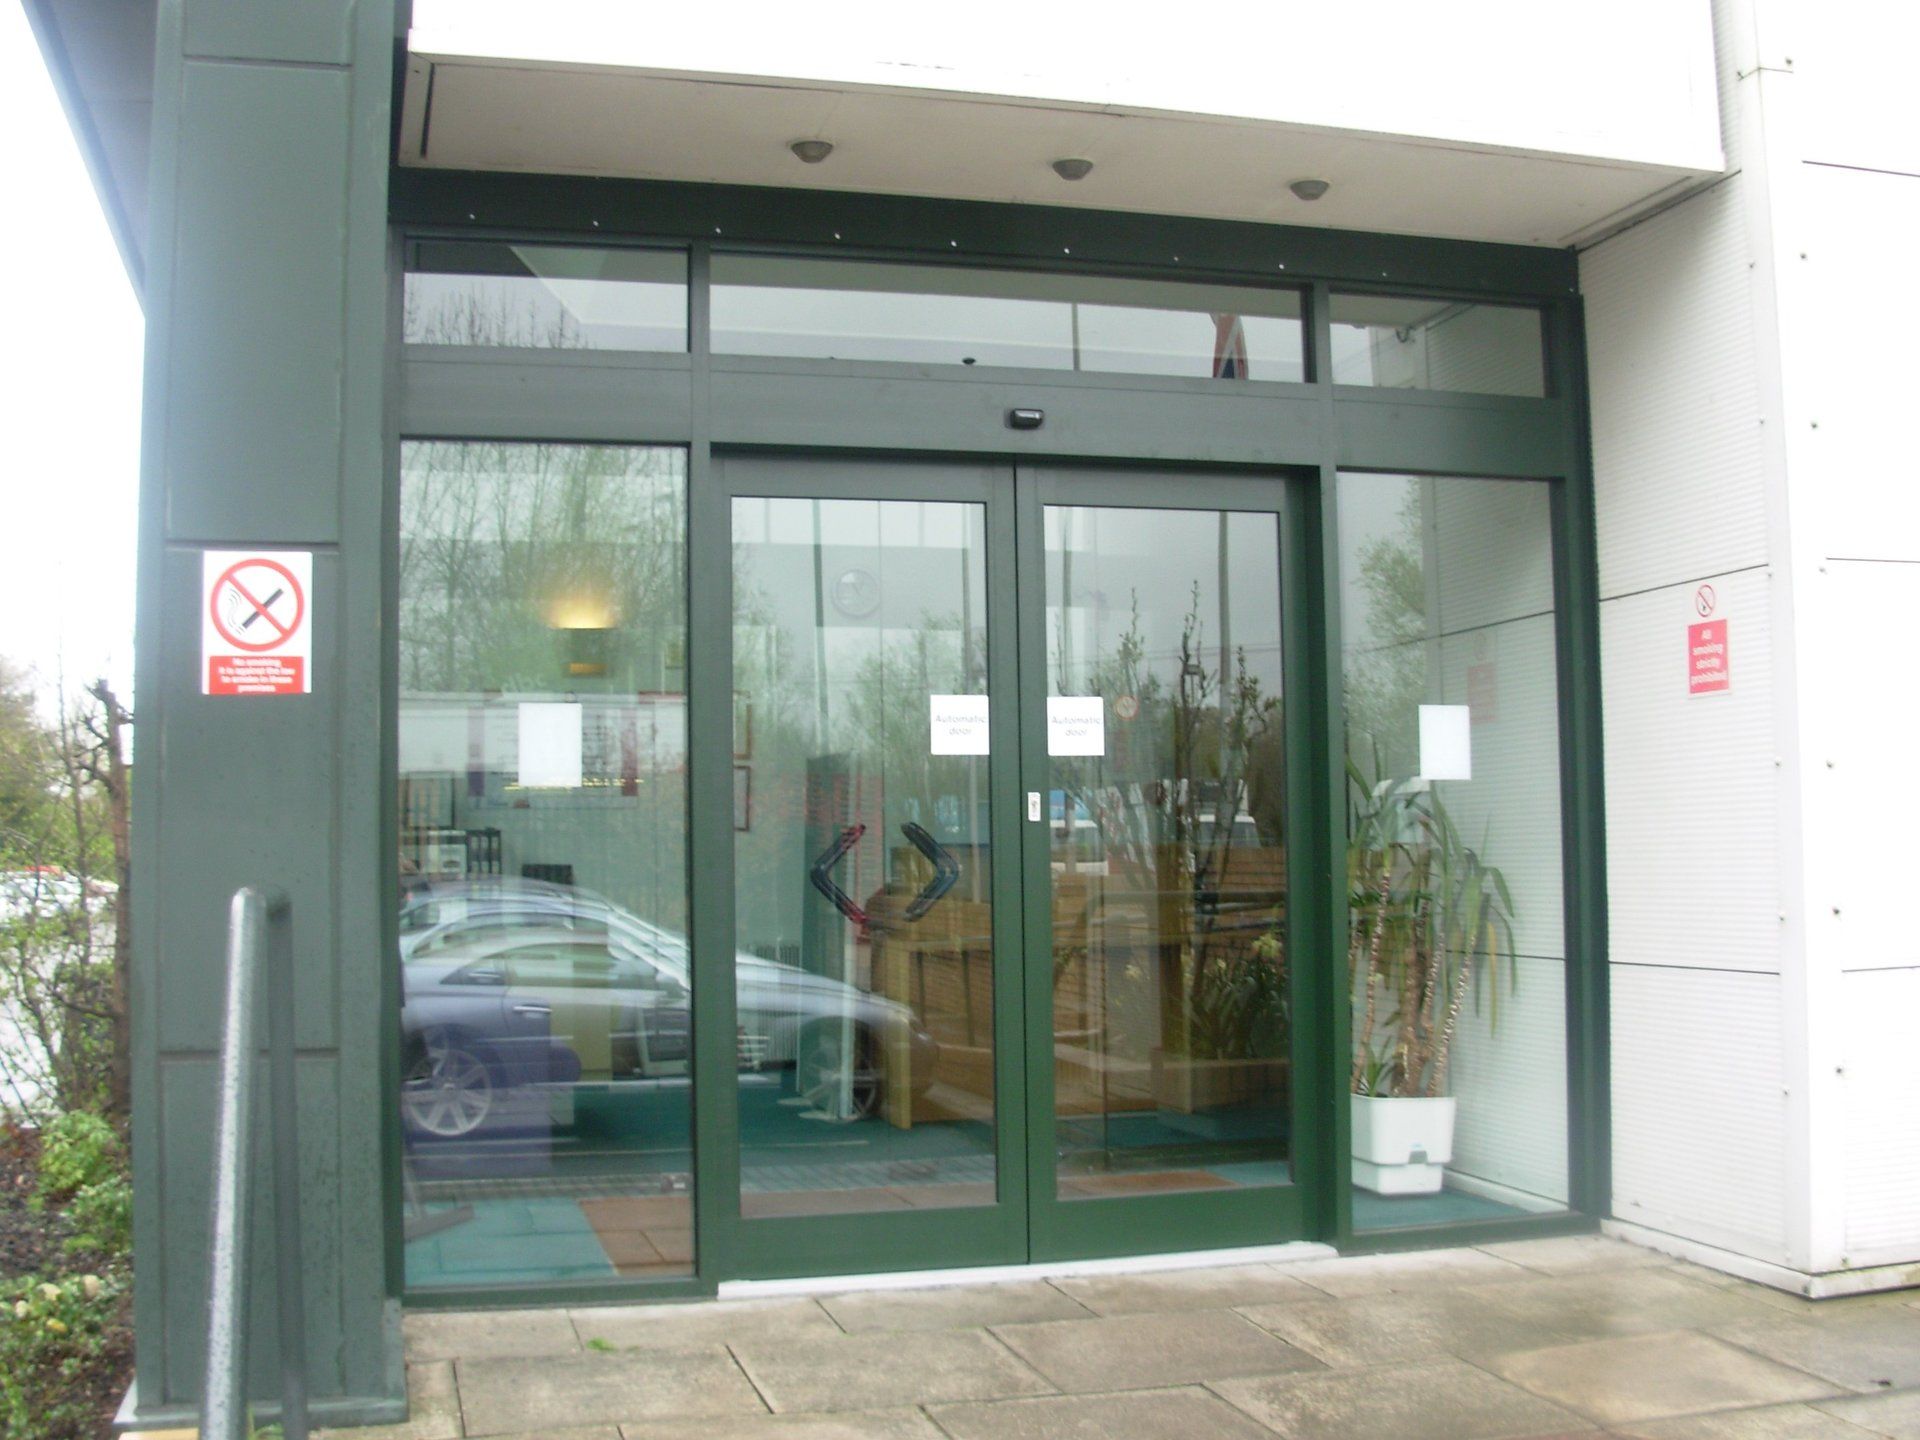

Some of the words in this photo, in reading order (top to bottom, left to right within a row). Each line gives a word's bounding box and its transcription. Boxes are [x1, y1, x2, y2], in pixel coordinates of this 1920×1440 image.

[935, 714, 986, 724] Automatic
[1051, 716, 1101, 725] Automatic
[948, 725, 973, 737] door
[1064, 728, 1088, 737] door
